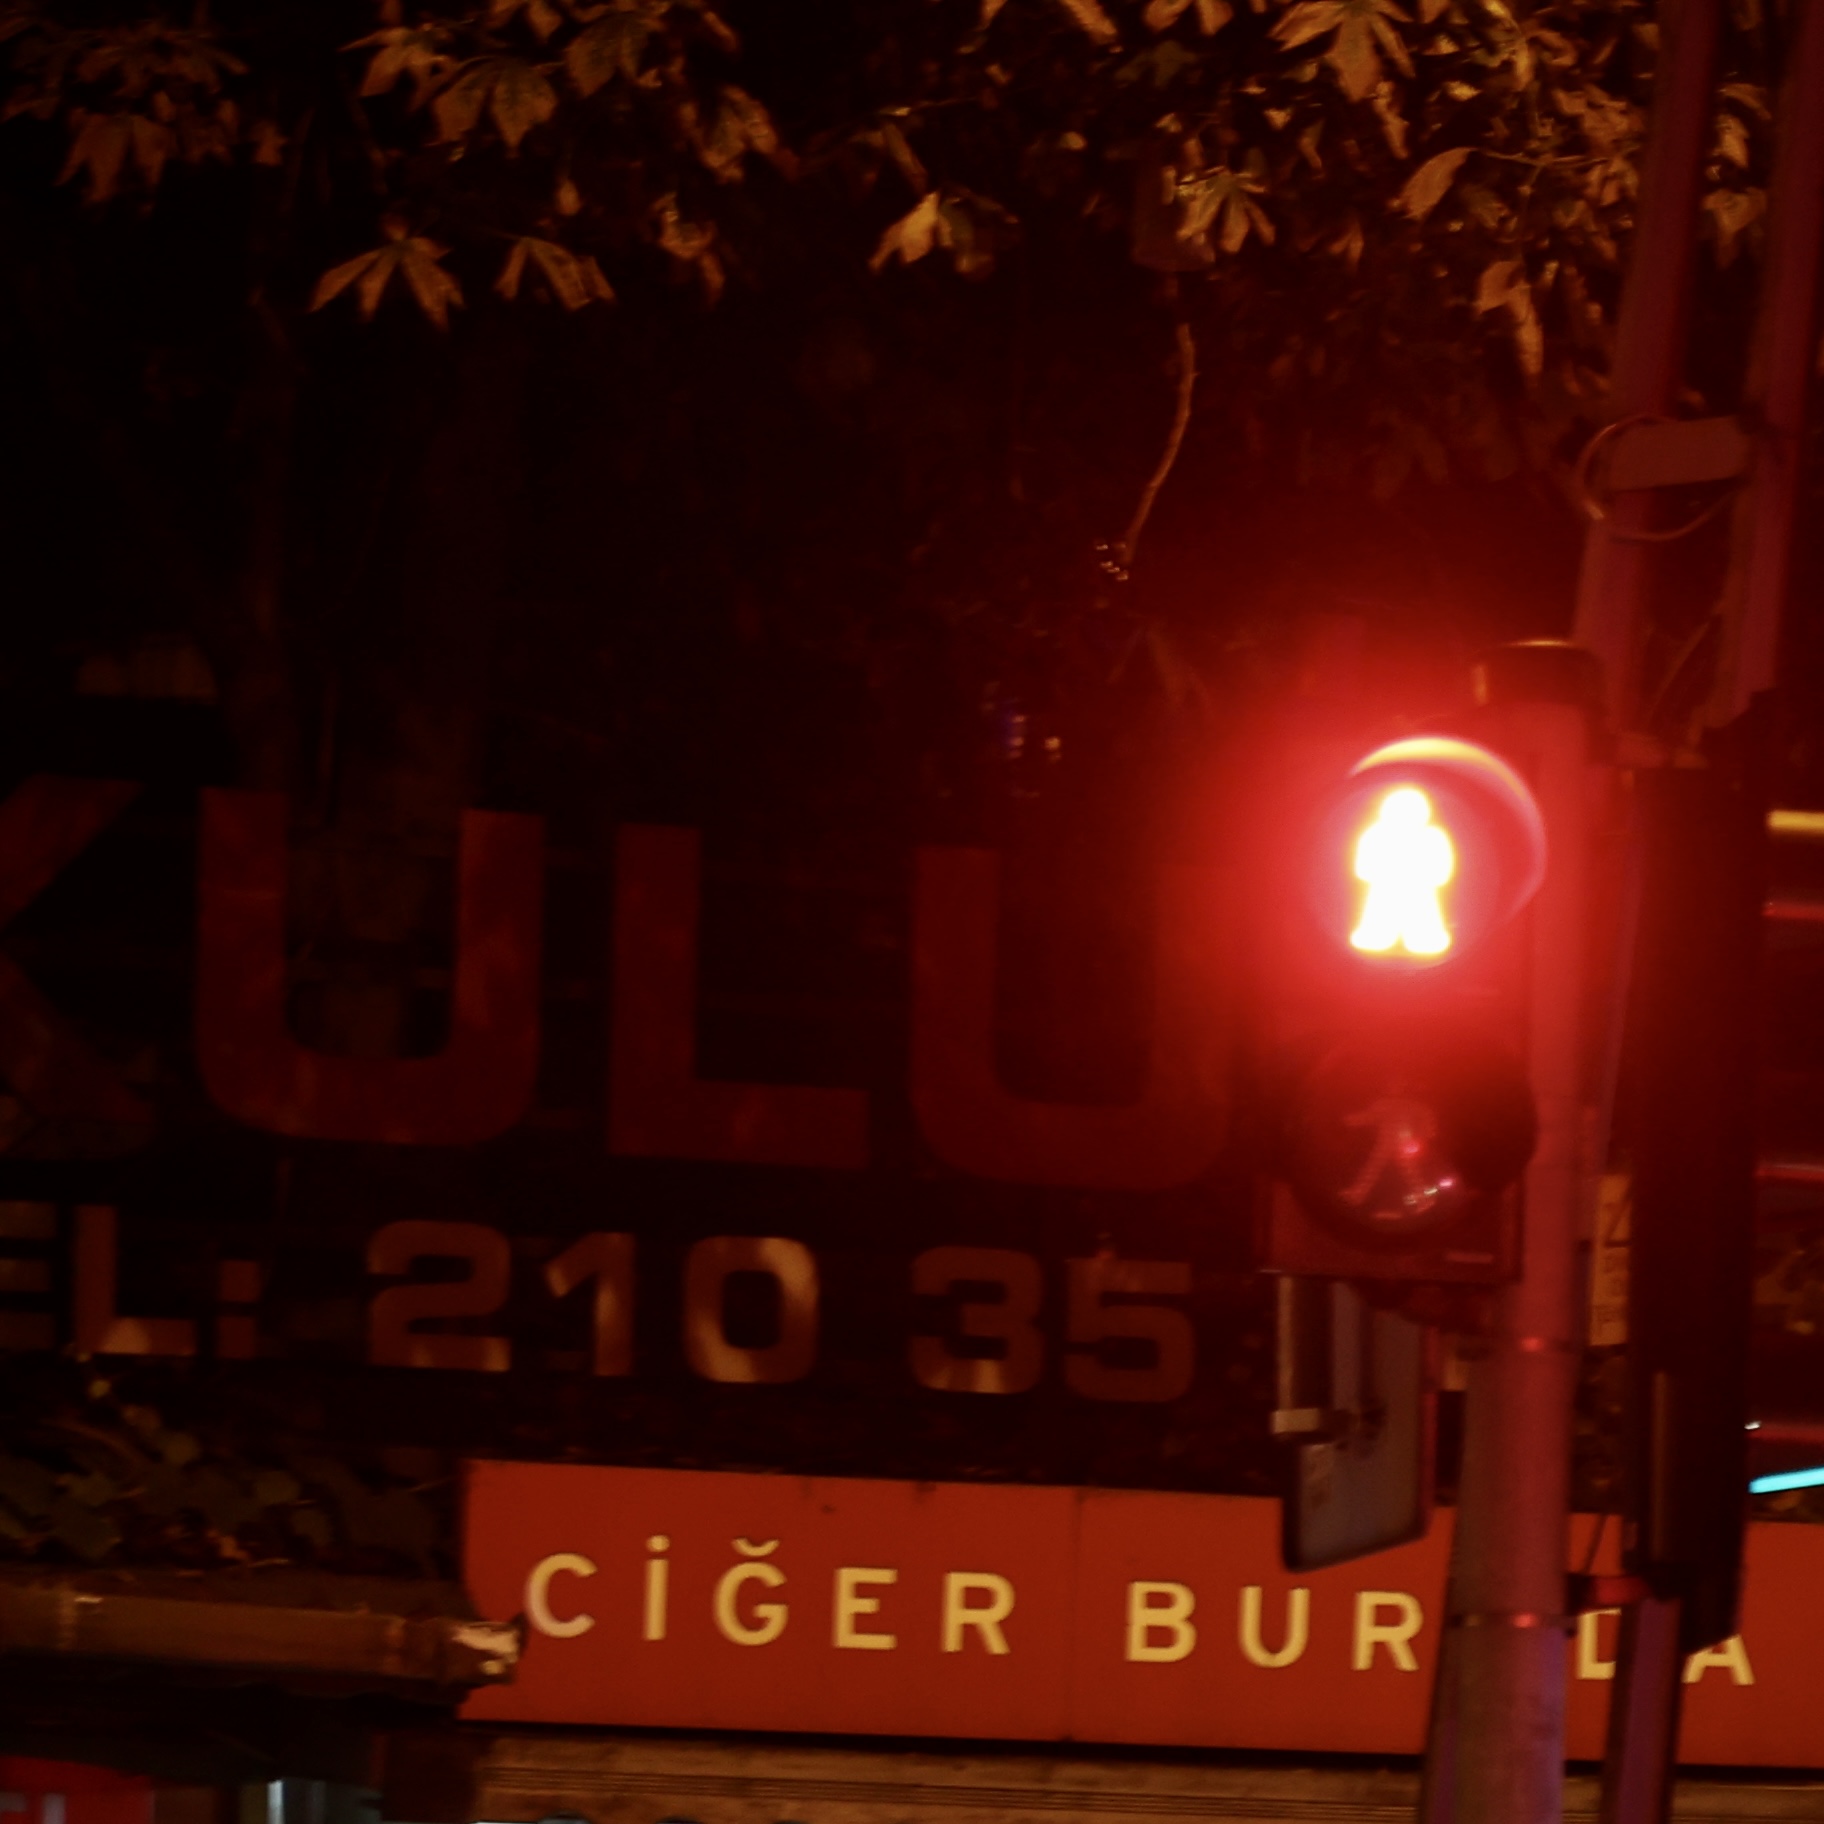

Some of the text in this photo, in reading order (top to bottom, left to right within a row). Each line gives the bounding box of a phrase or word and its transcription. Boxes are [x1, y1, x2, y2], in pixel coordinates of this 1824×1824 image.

[366, 1219, 820, 1384] 210
[908, 1245, 1195, 1402] 35
[524, 1535, 1016, 1655] CİĞER
